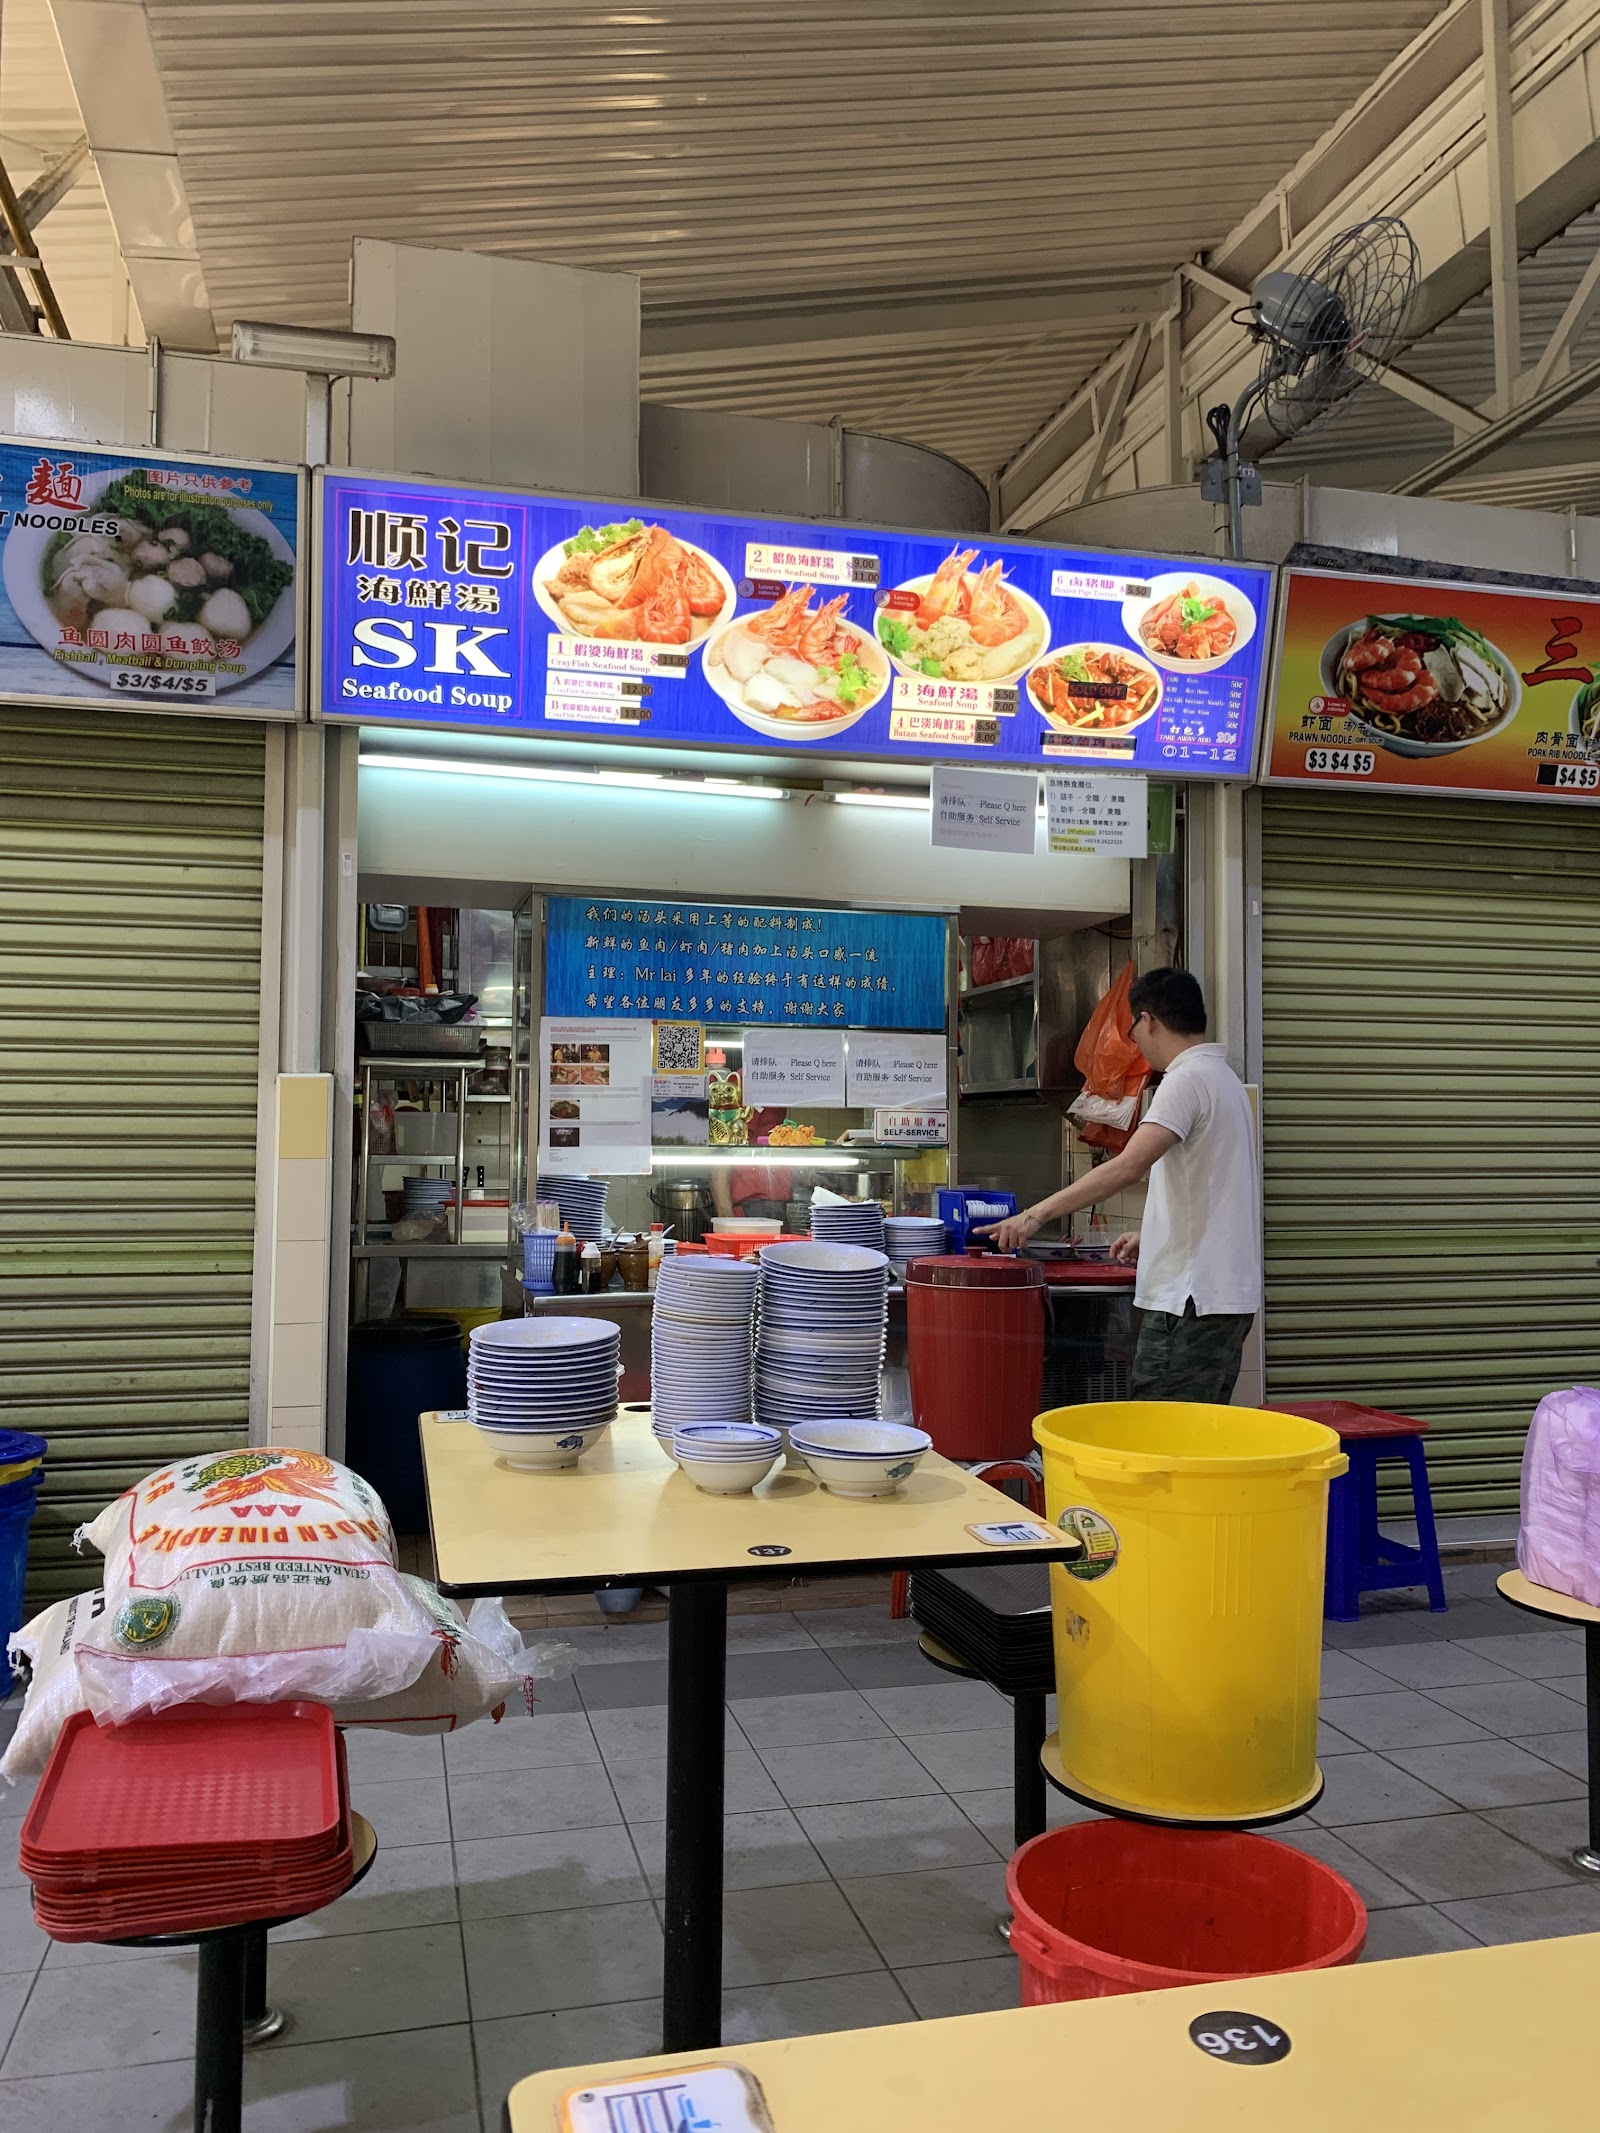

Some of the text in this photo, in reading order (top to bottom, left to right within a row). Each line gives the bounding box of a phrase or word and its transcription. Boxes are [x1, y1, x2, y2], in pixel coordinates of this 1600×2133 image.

[147, 470, 253, 493] 图片只供参考
[124, 485, 256, 510] Photos are for illustration purposes
[14, 512, 119, 536] NOODLES
[347, 508, 513, 578] 顺记
[753, 550, 762, 562] 2
[749, 565, 840, 581] Pomfret Seafood Soup
[1057, 576, 1063, 585] 6
[357, 575, 500, 614] 海鮮湯
[352, 617, 512, 678] SK
[558, 641, 564, 654] 1
[1521, 616, 1594, 687] 三
[54, 650, 246, 674] Fishball Meatball & Dumpling Soup
[551, 658, 650, 674] CrayFish Seafood Soup
[116, 673, 208, 692] $3/$4/$5
[553, 676, 561, 685] A
[342, 678, 513, 713] Seafood Soup
[900, 683, 908, 695] 3
[917, 684, 978, 700] 海鮮湯
[1069, 684, 1122, 697] SOLD OUT
[551, 700, 559, 709] B
[918, 698, 953, 707] Seafood
[956, 701, 978, 710] Soup
[897, 717, 904, 728] 4
[1301, 715, 1333, 731] 虾面
[894, 729, 970, 742] Batam Seafood Soup
[1289, 732, 1318, 742] PRAWN
[1320, 734, 1352, 744] NOODLE
[1535, 731, 1580, 748] 肉骨面
[1308, 750, 1371, 772] $3 $4 $5
[1528, 748, 1547, 757] PORK
[1549, 749, 1560, 758] RIB
[1563, 751, 1591, 760] NOODLE
[1560, 767, 1597, 786] $4 $5
[940, 795, 1027, 812] 请排队 Please Q here
[940, 810, 1020, 826] 自助服务 Self Service
[635, 966, 656, 982] Mr
[660, 966, 677, 982] lai
[751, 1057, 836, 1068] 请排队 Please Q here
[855, 1058, 938, 1070] 请排队 Please Q here
[751, 1071, 831, 1082] 自助服务 Self Service
[855, 1072, 932, 1083] 自助服务 Self Service
[889, 1116, 936, 1127] 自助服務
[884, 1128, 939, 1136] SELF-SERVICE
[230, 1504, 302, 1518] AAA
[137, 1524, 289, 1552] PINEAPPLE
[751, 1547, 785, 1555] 137
[235, 1561, 271, 1572] BEST
[275, 1562, 371, 1580] GUARANTEED
[1197, 2025, 1281, 2055] 136
